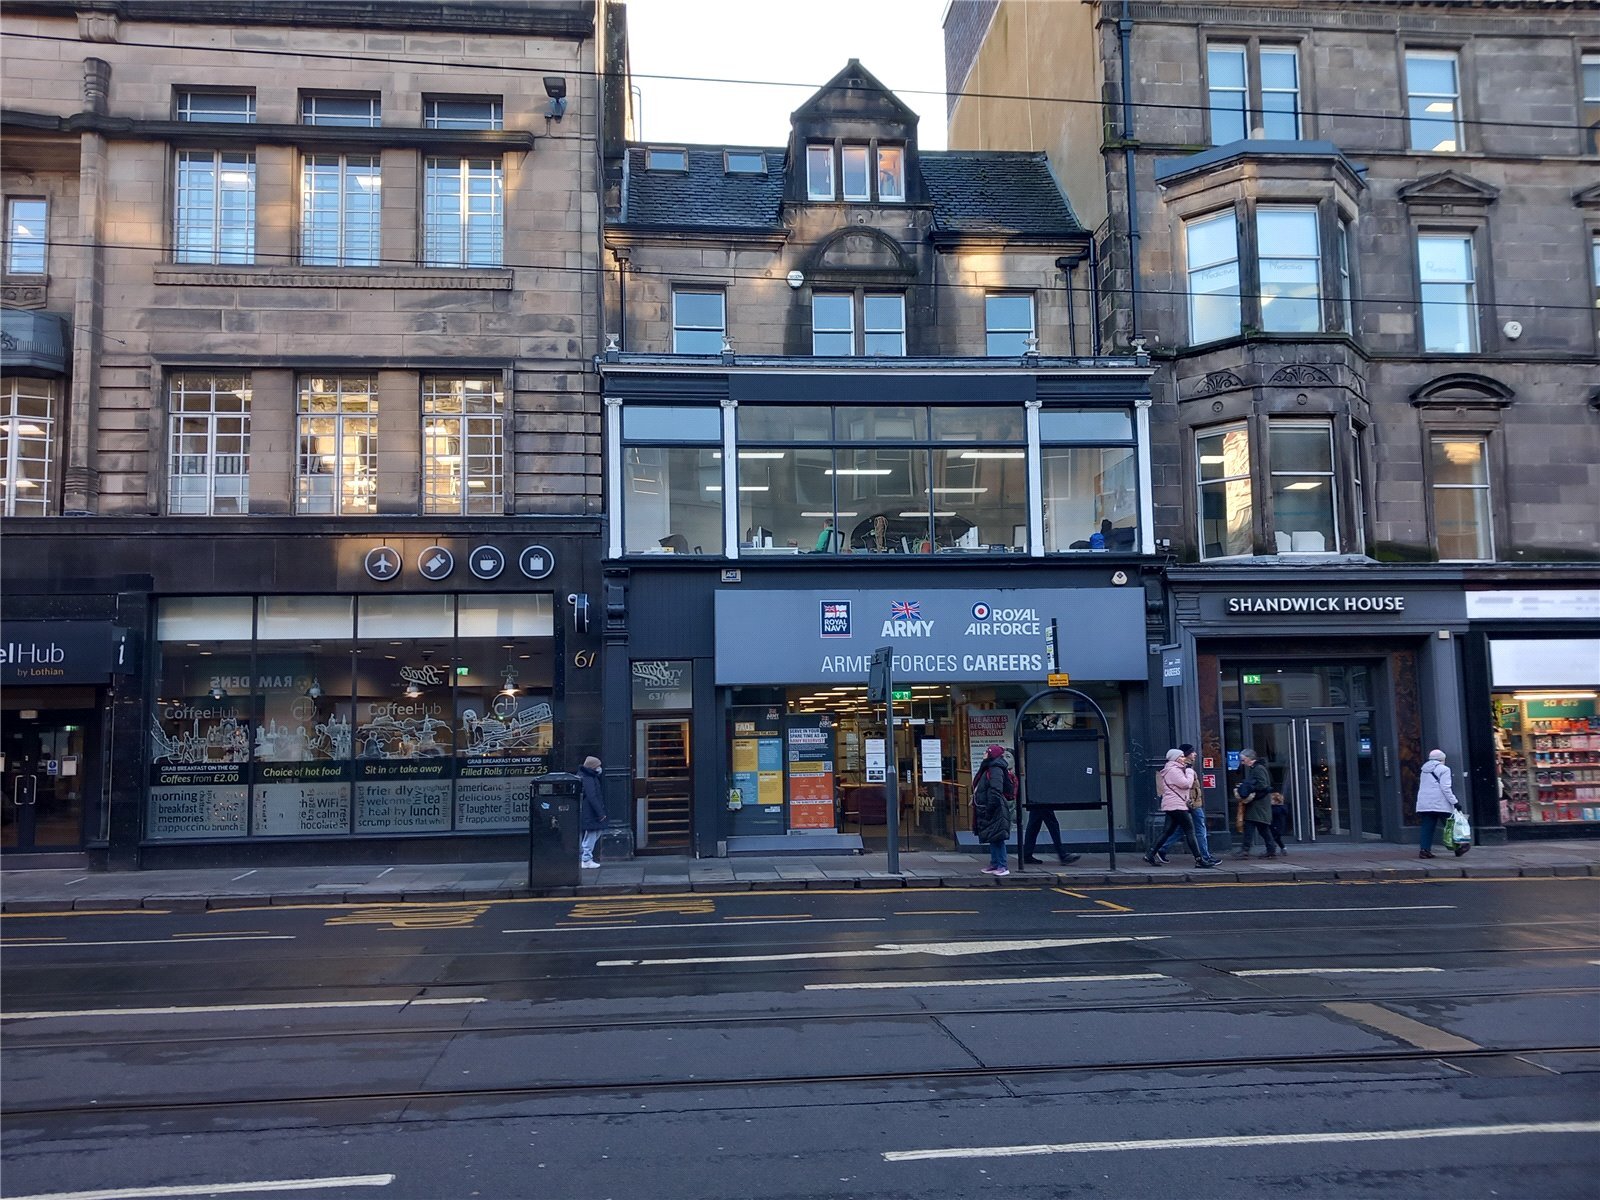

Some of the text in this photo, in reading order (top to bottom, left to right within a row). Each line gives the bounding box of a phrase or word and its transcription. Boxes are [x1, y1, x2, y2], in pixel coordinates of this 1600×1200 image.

[1229, 596, 1405, 612] SHANDWICK HOUSE
[993, 608, 1040, 621] ROYAL
[880, 620, 935, 637] ARMY
[964, 622, 1040, 636] AIR FORCE
[574, 649, 596, 668] 61
[821, 654, 1042, 673] ARME FORCES CAREERS
[17, 667, 64, 678] by Lothian
[644, 678, 680, 687] HOUSE
[164, 705, 239, 720] CoffeeHub
[368, 702, 441, 716] CoffeeHub
[263, 767, 293, 777] Choice
[304, 767, 320, 776] hot
[321, 766, 342, 776] food
[364, 764, 443, 775] Sit in or take away
[460, 765, 548, 776] Filled Rolls from £2.25
[160, 773, 239, 784] Coffees from £2.00
[151, 790, 198, 803] morning
[423, 793, 440, 804] tea
[458, 794, 502, 802] delicious
[511, 792, 530, 801] cos
[306, 788, 315, 821] bagels
[316, 798, 339, 808] WiFi
[512, 802, 529, 813] latt
[158, 803, 198, 815] breakfast
[316, 809, 339, 819] calm
[368, 806, 407, 817] healhy
[409, 804, 440, 816] lunch
[466, 803, 503, 816] laughter
[158, 814, 205, 823] memories
[358, 818, 414, 827] scrumpious
[465, 815, 510, 825] frappuccino
[157, 823, 211, 833] cappuccino
[211, 822, 239, 831] brunch
